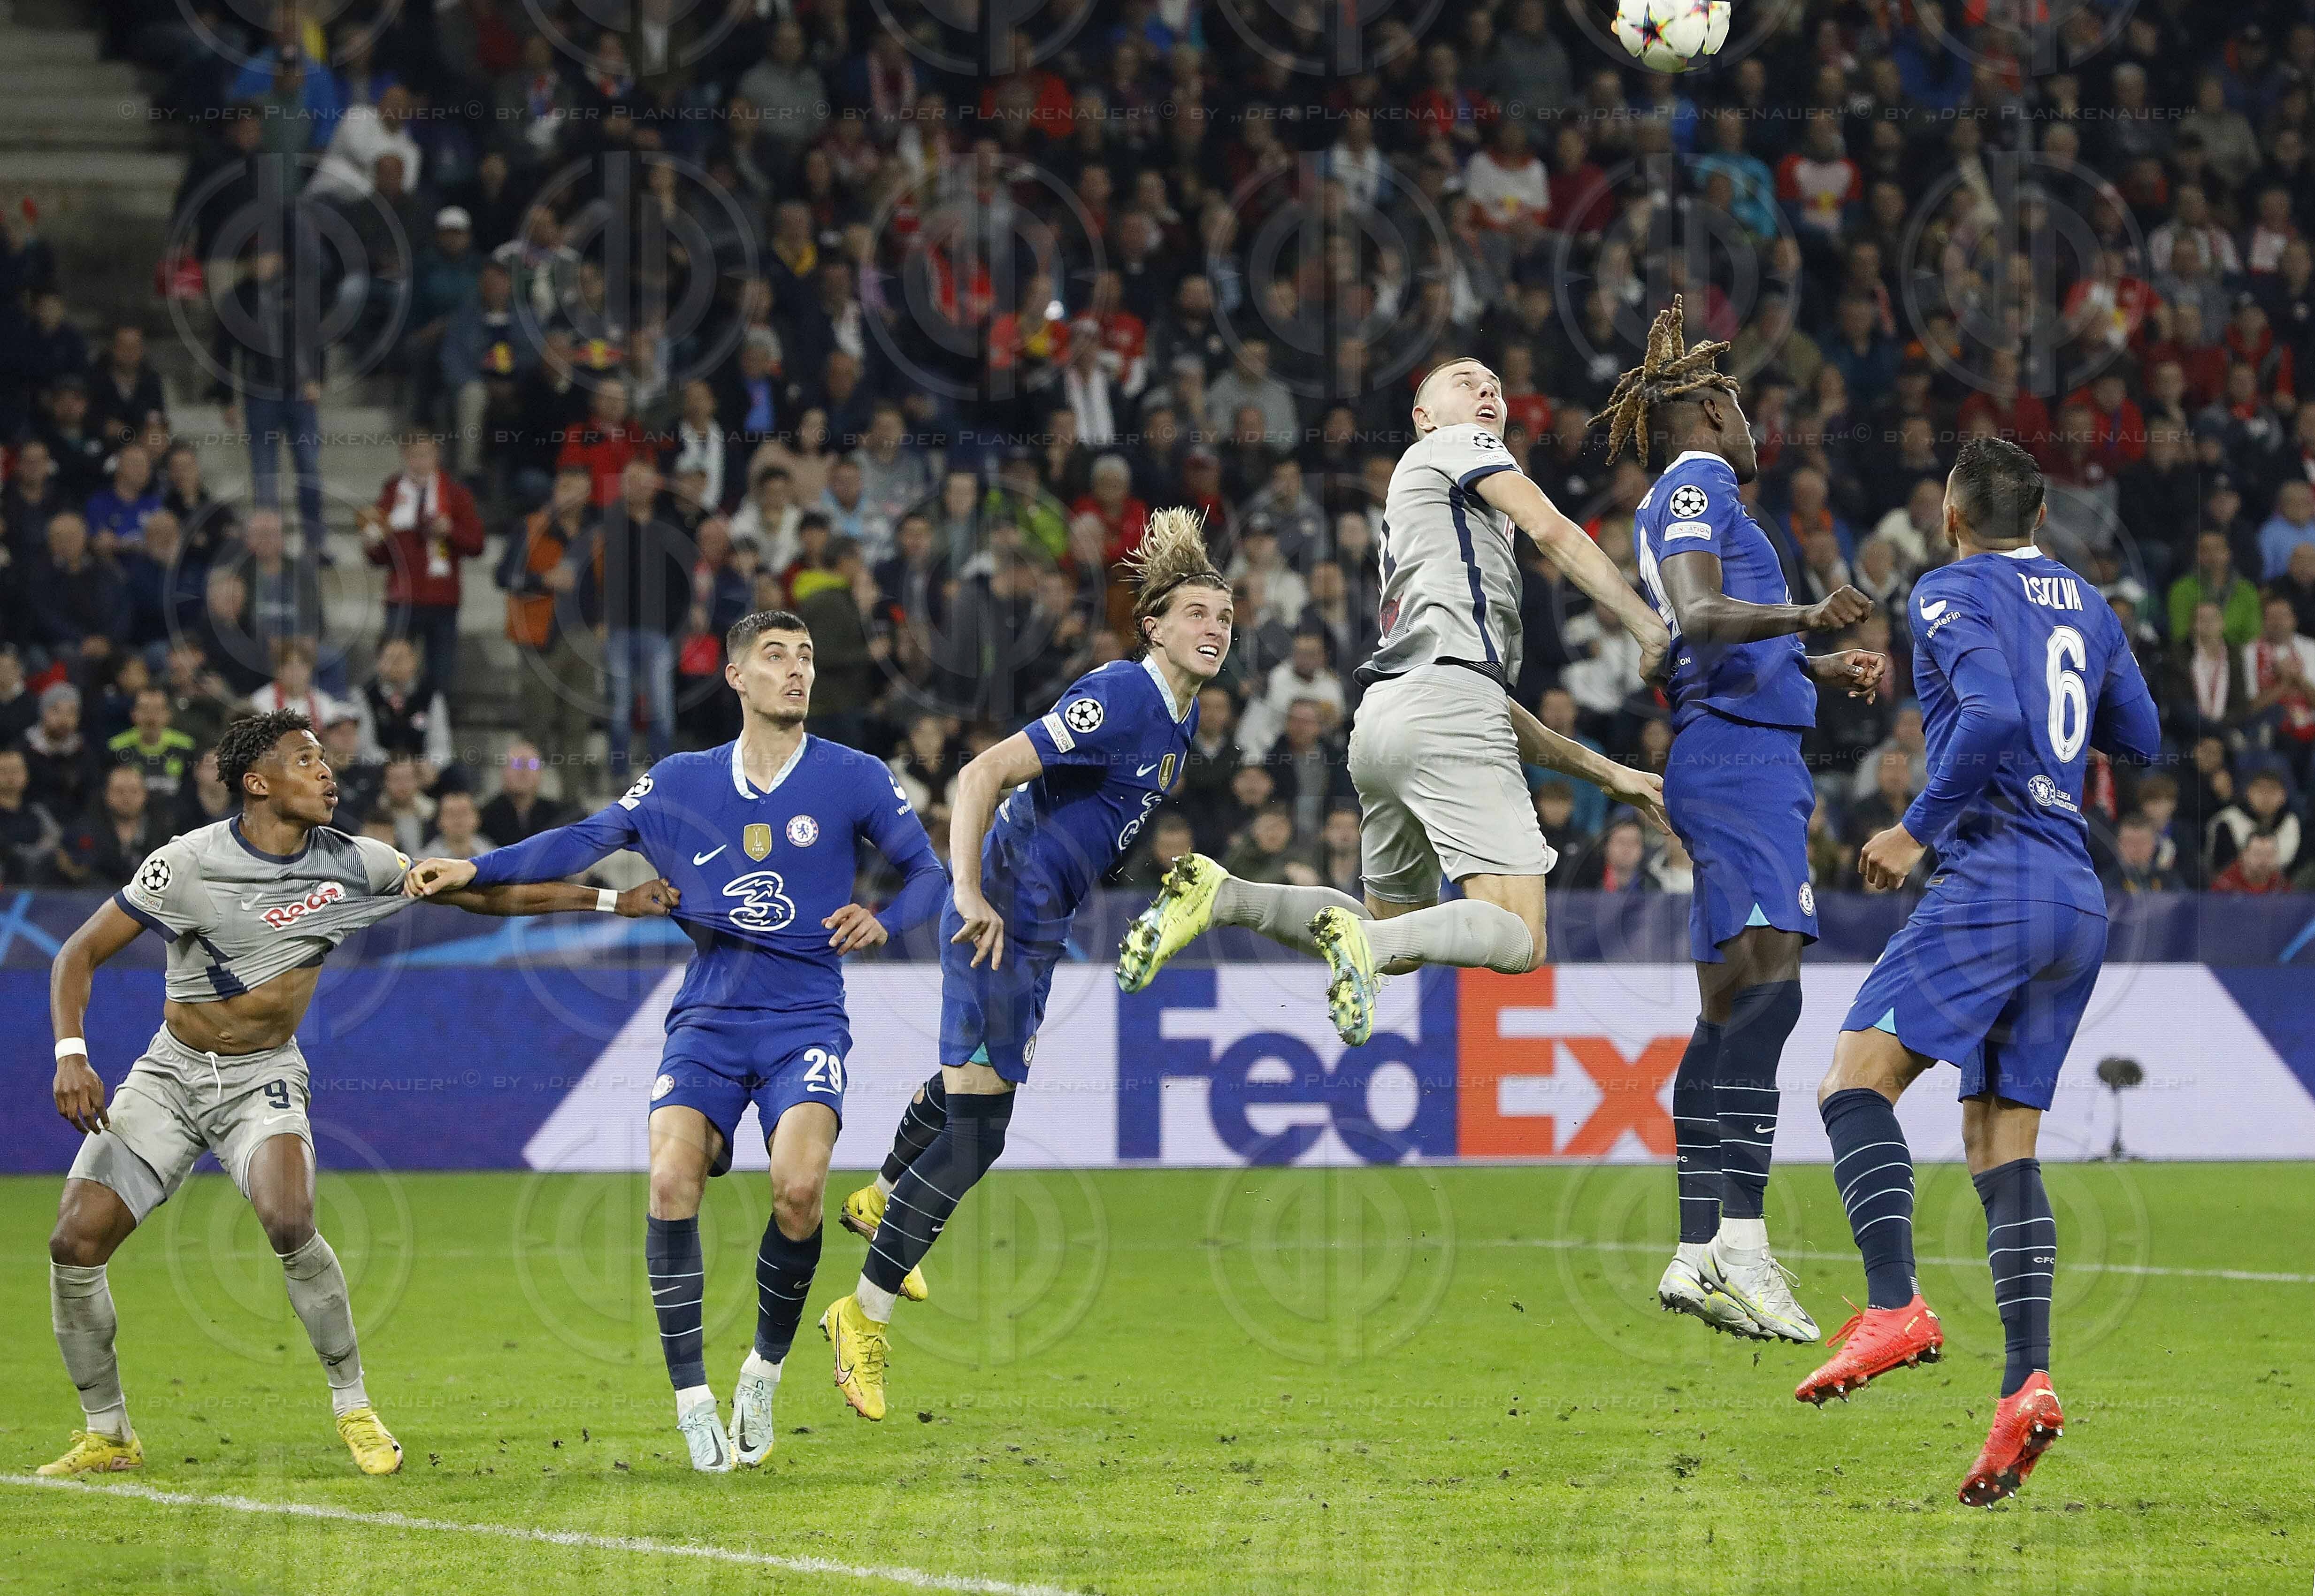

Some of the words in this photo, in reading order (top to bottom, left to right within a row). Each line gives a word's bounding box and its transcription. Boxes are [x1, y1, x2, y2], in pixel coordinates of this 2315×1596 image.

[2047, 625, 2088, 763] 6
[262, 1078, 291, 1108] 9
[803, 1048, 842, 1093] 29
[1118, 966, 1691, 1165] FedEx
